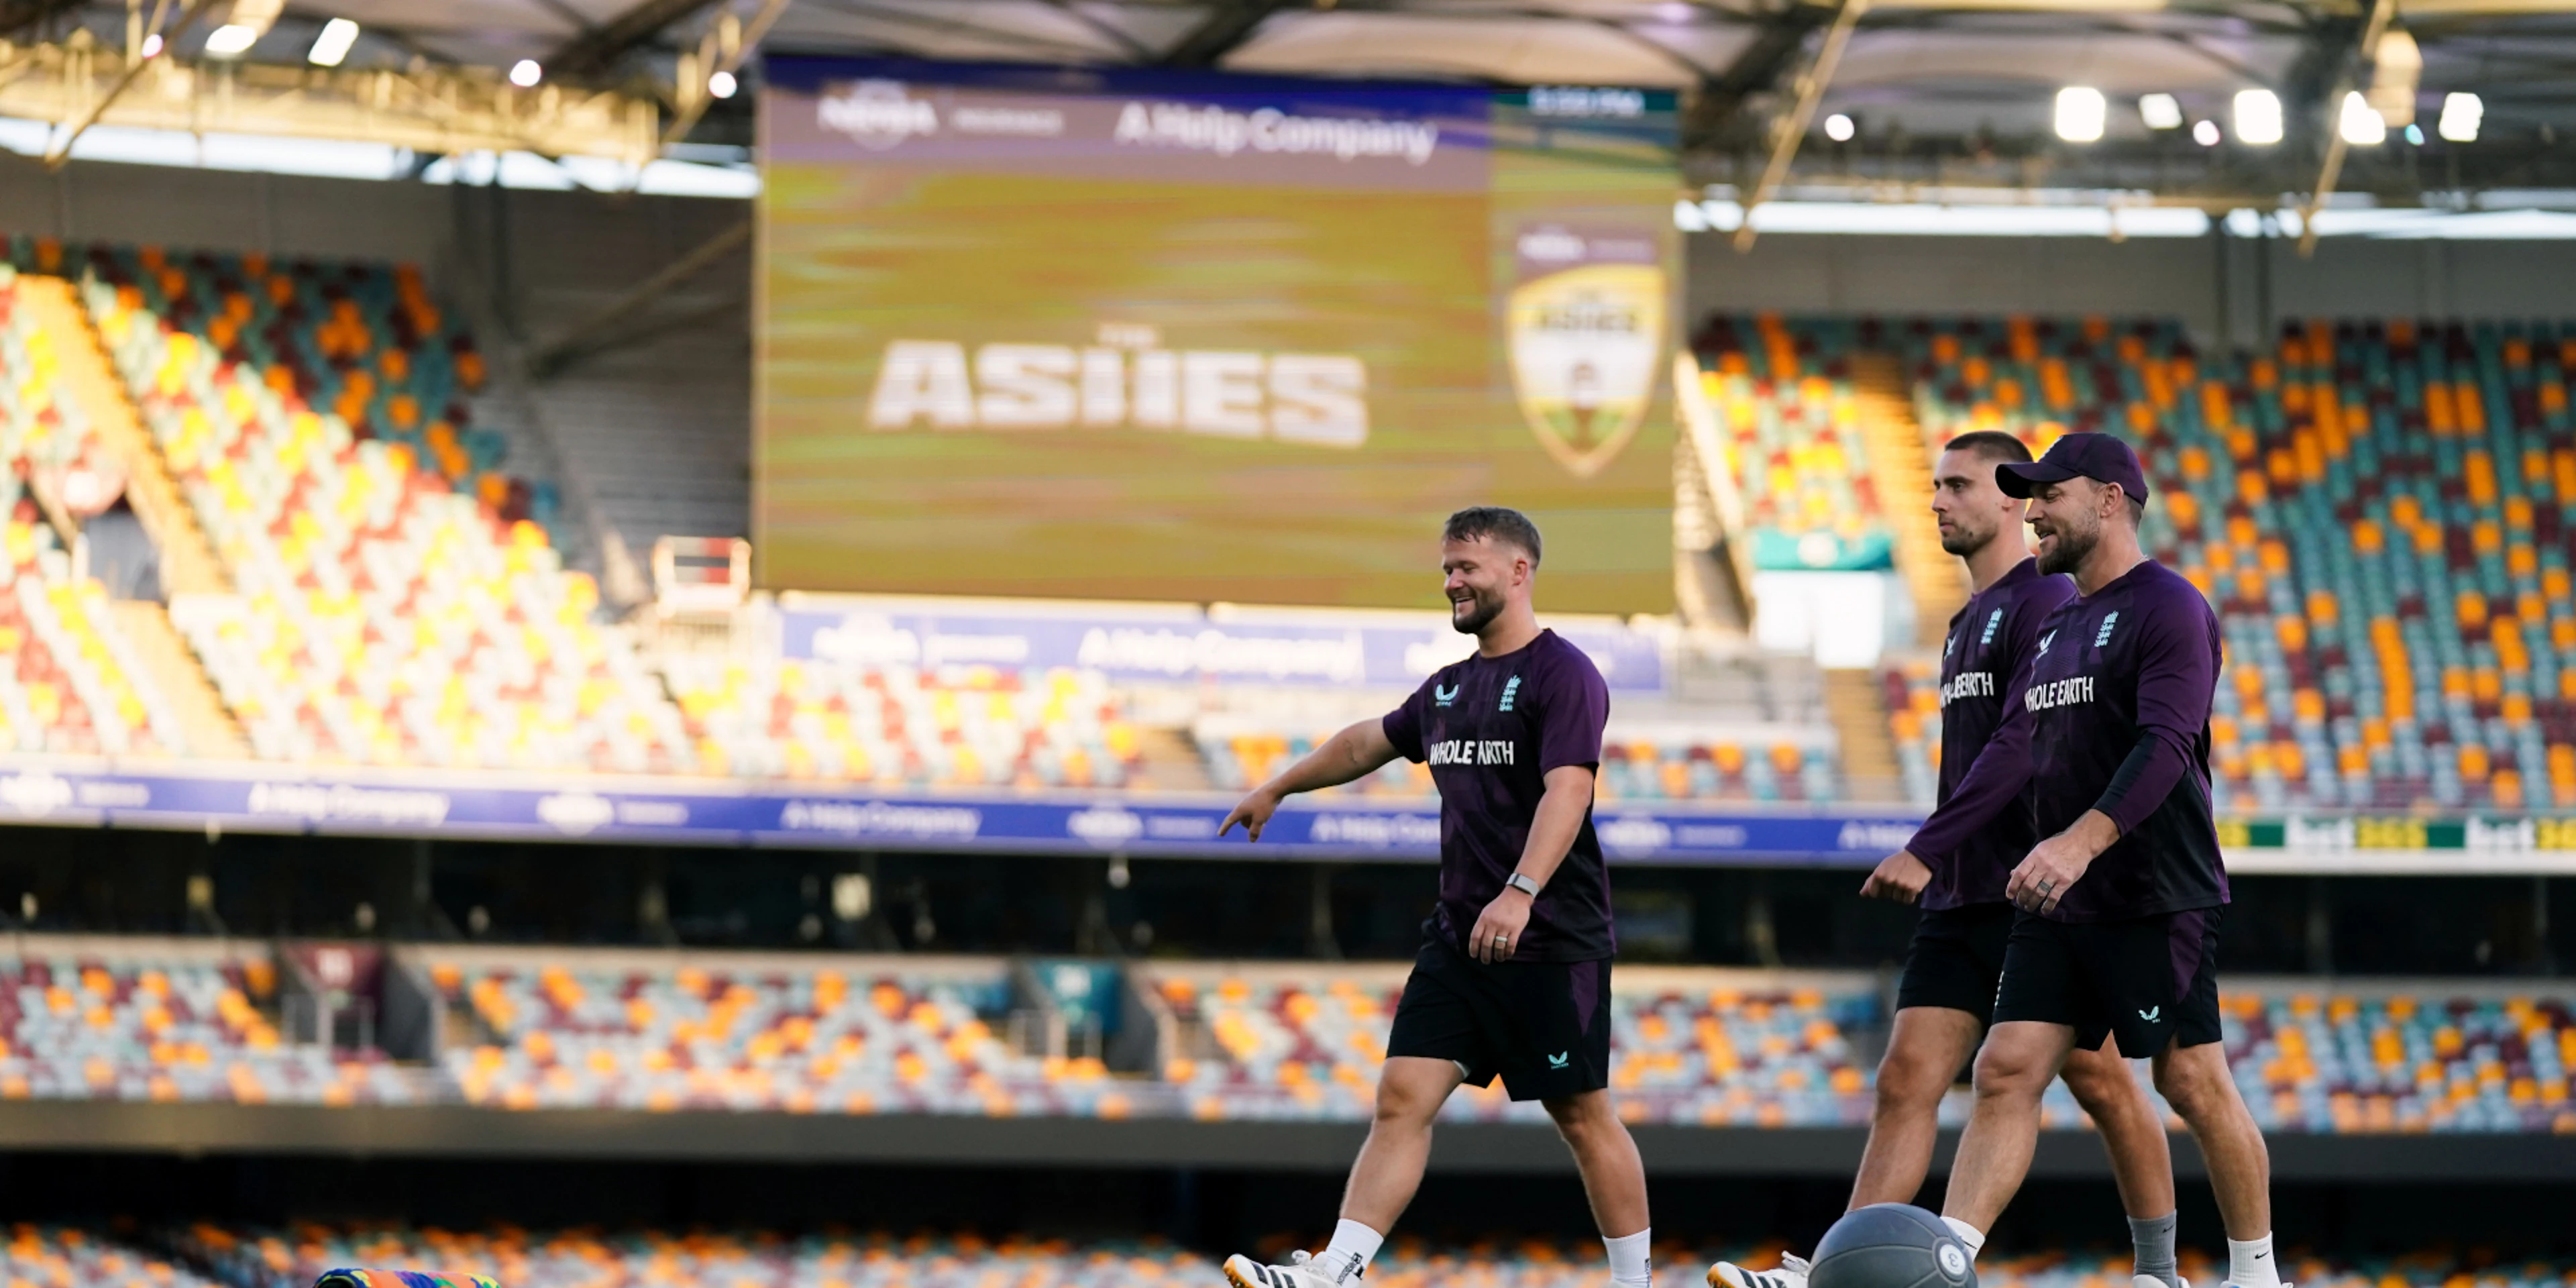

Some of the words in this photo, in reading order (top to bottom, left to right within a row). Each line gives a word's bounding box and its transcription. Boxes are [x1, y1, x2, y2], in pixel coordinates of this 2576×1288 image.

[1115, 101, 1150, 146] A
[1151, 102, 1248, 157] Help
[1249, 107, 1438, 166] Company
[868, 339, 1368, 449] ASHES
[2057, 676, 2094, 706] EARTH
[1430, 739, 1475, 765] WHOLE
[1477, 740, 1514, 765] ARTH
[2284, 812, 2428, 849] bet365
[2465, 812, 2576, 849] bet36
